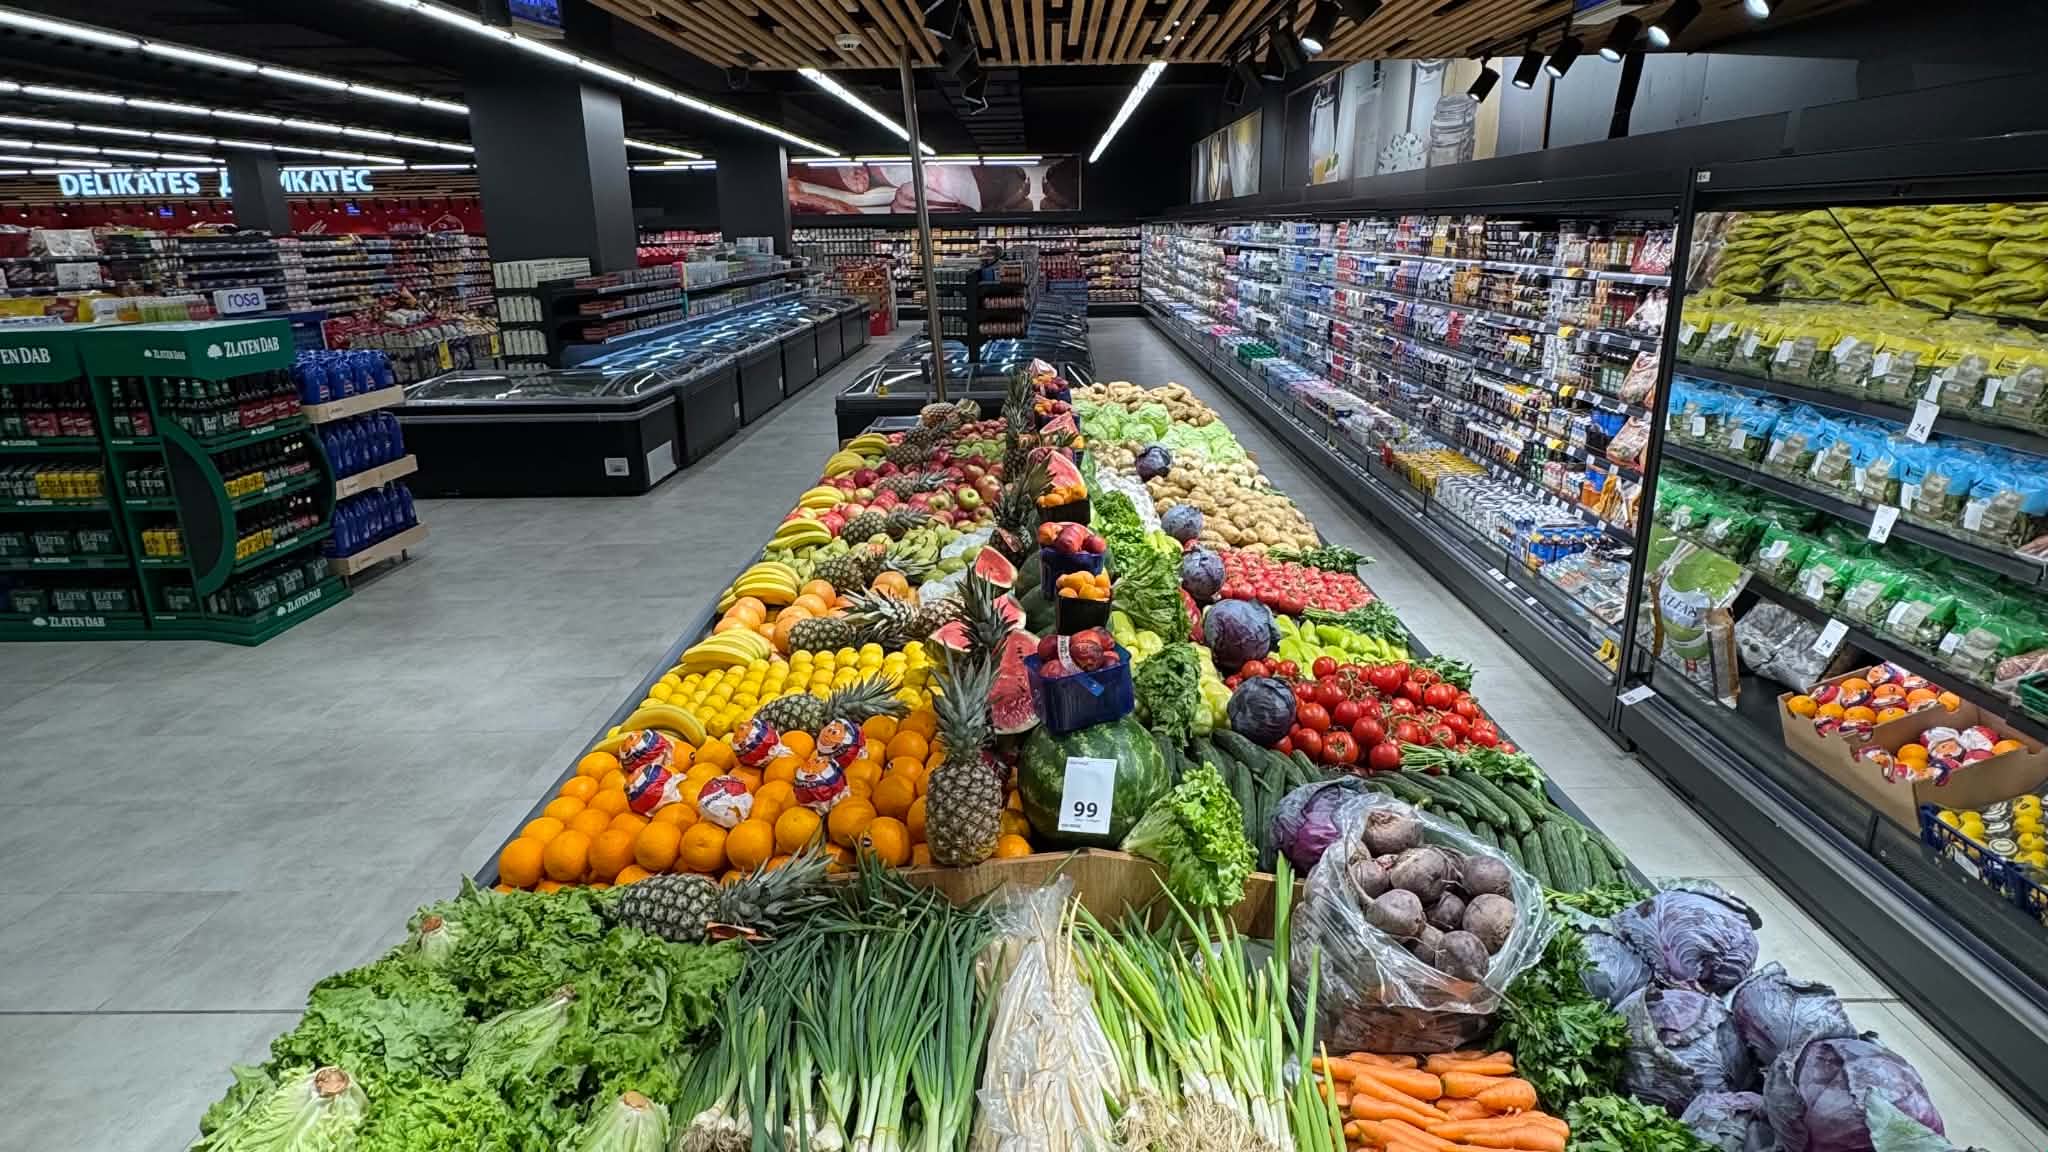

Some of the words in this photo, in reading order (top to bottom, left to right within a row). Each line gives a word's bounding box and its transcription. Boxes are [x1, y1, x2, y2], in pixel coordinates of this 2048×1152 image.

[59, 172, 201, 196] DELIKATES
[228, 293, 260, 308] rosa
[19, 347, 51, 363] DAB
[224, 339, 261, 358] ZLATEN
[260, 336, 280, 352] DAB
[1914, 423, 1926, 434] 74
[287, 596, 310, 613] ZLATEN
[48, 616, 86, 628] ZLATEN
[85, 616, 106, 628] DAB
[1073, 801, 1098, 818] 99
